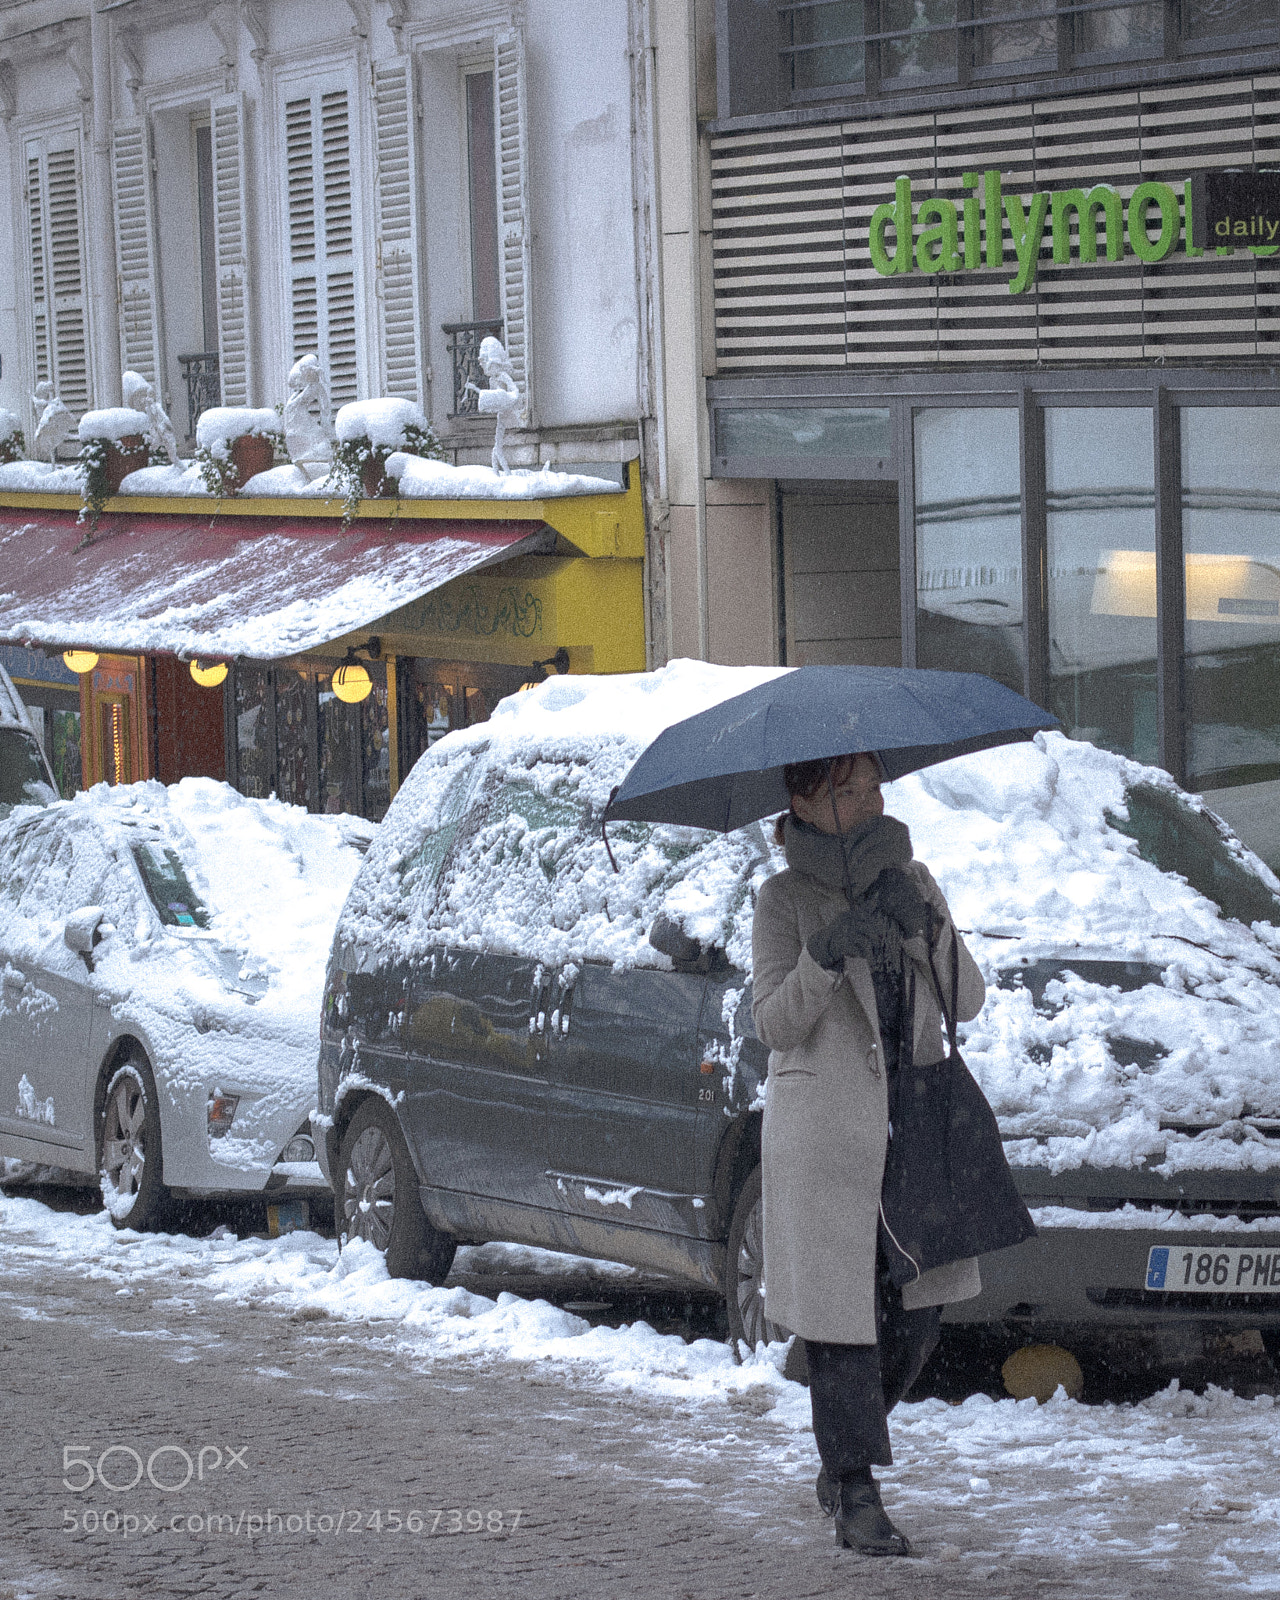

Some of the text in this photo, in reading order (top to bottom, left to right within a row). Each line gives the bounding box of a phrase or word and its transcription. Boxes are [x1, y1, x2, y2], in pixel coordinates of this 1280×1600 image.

[1214, 215, 1280, 241] daily
[1153, 1272, 1160, 1281] F
[1182, 1252, 1230, 1286] 186
